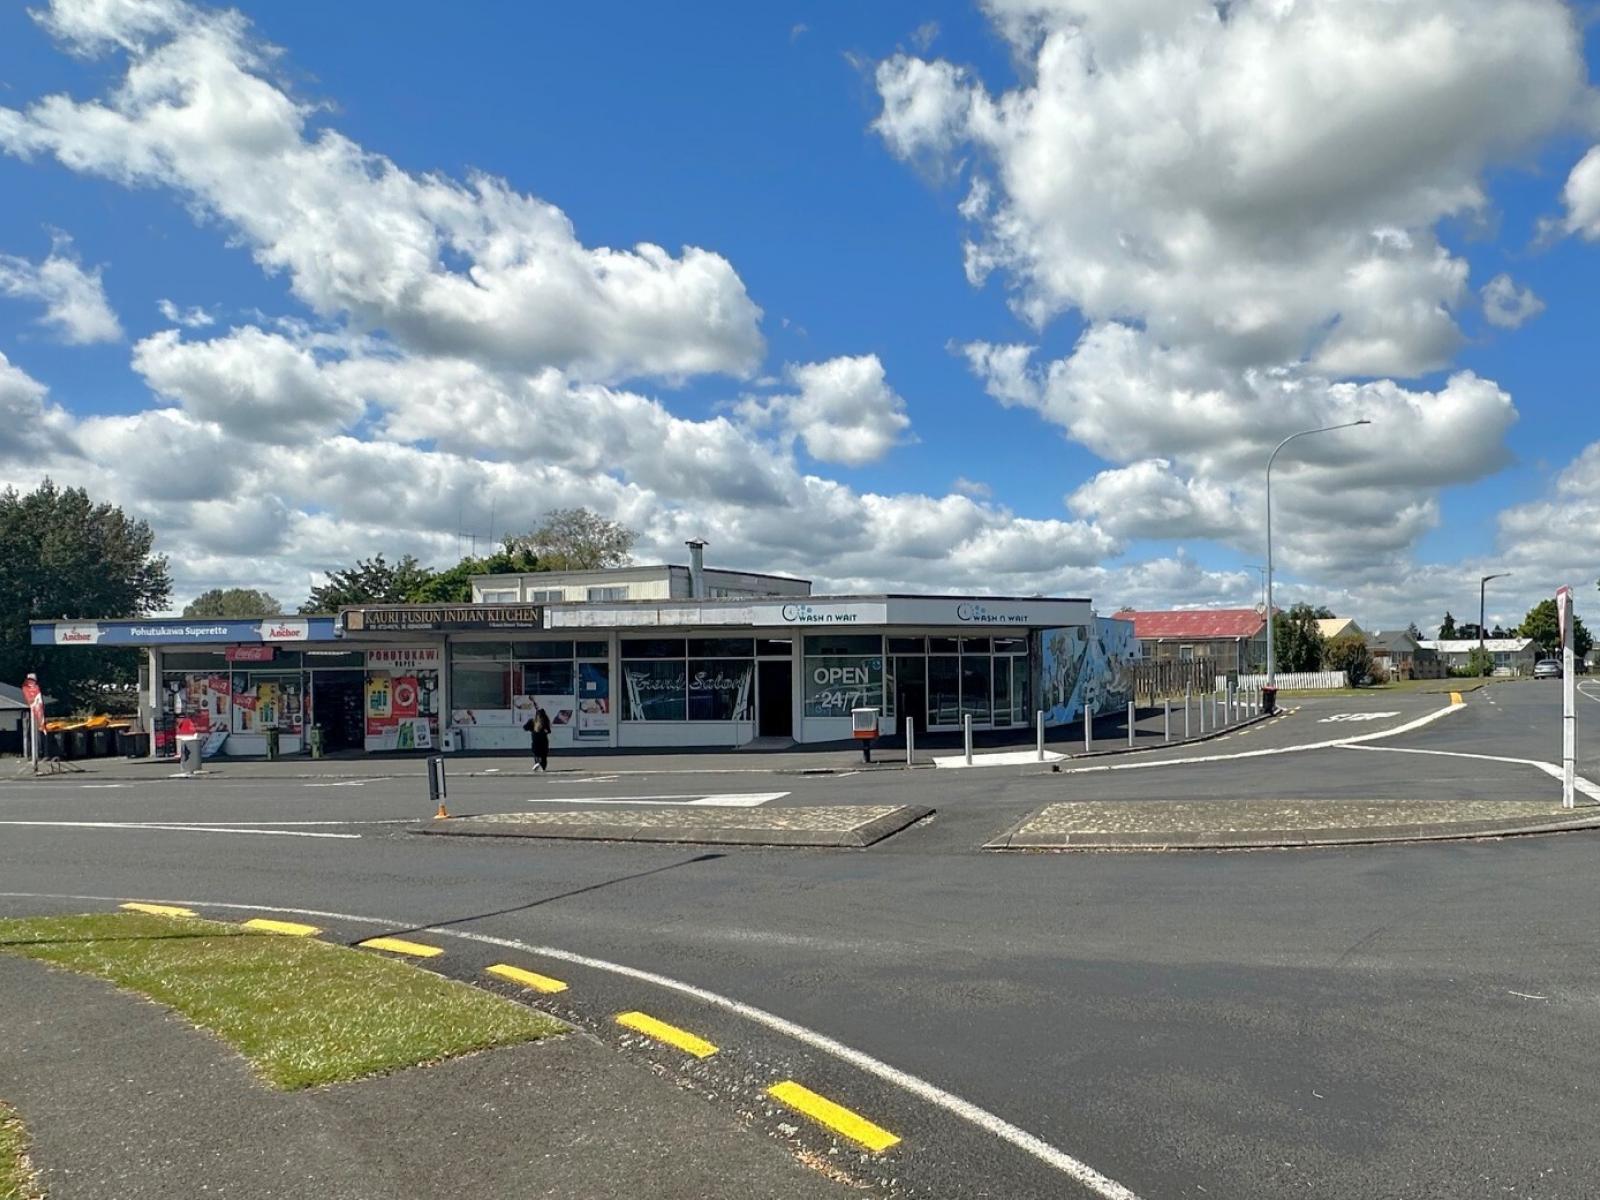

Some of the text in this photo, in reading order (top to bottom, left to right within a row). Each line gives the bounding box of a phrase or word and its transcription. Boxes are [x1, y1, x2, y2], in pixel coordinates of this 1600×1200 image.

[366, 609, 538, 624] KAURI FUSION INDIAN KITCHEN
[799, 614, 824, 622] WASH
[835, 613, 858, 621] WAIT
[62, 632, 91, 641] Anchor
[130, 626, 228, 637] Pohutukawa Superette
[269, 628, 301, 638] Anchor
[813, 667, 869, 684] OPEN
[821, 691, 861, 712] 24/7
